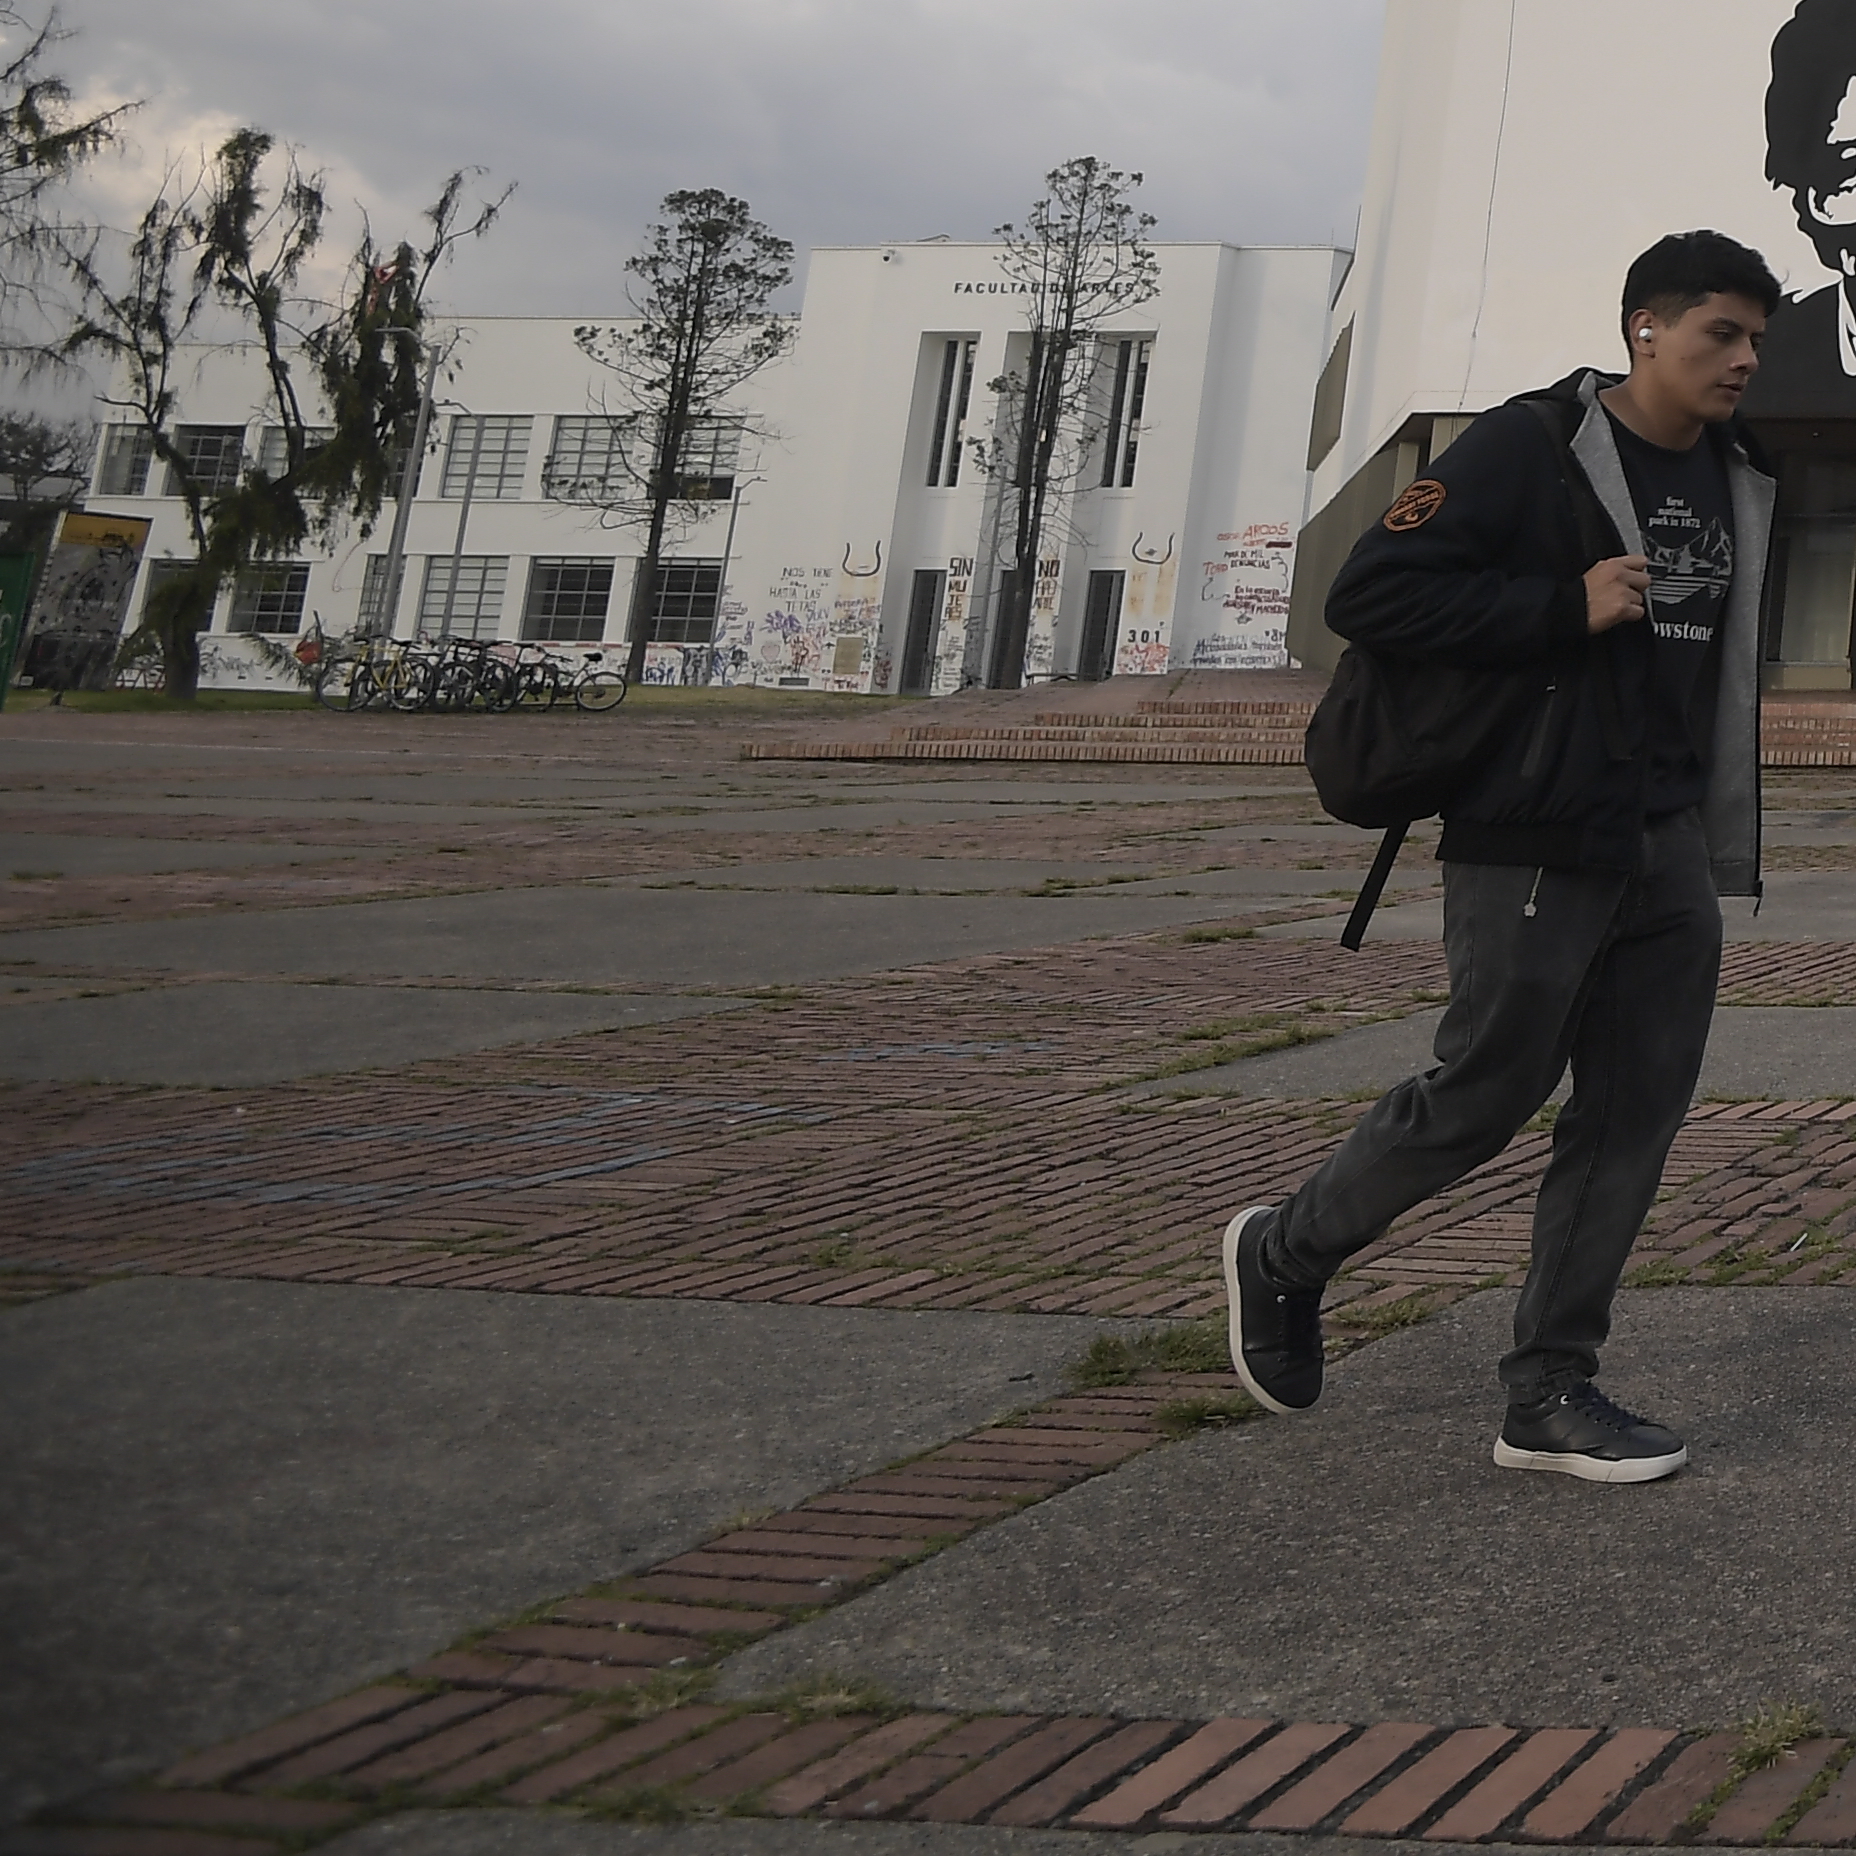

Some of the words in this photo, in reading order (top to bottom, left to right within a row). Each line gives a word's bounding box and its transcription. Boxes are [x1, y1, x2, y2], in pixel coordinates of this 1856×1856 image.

[949, 557, 974, 577] SIN
[1038, 559, 1061, 577] NO
[1128, 629, 1160, 643] 301
